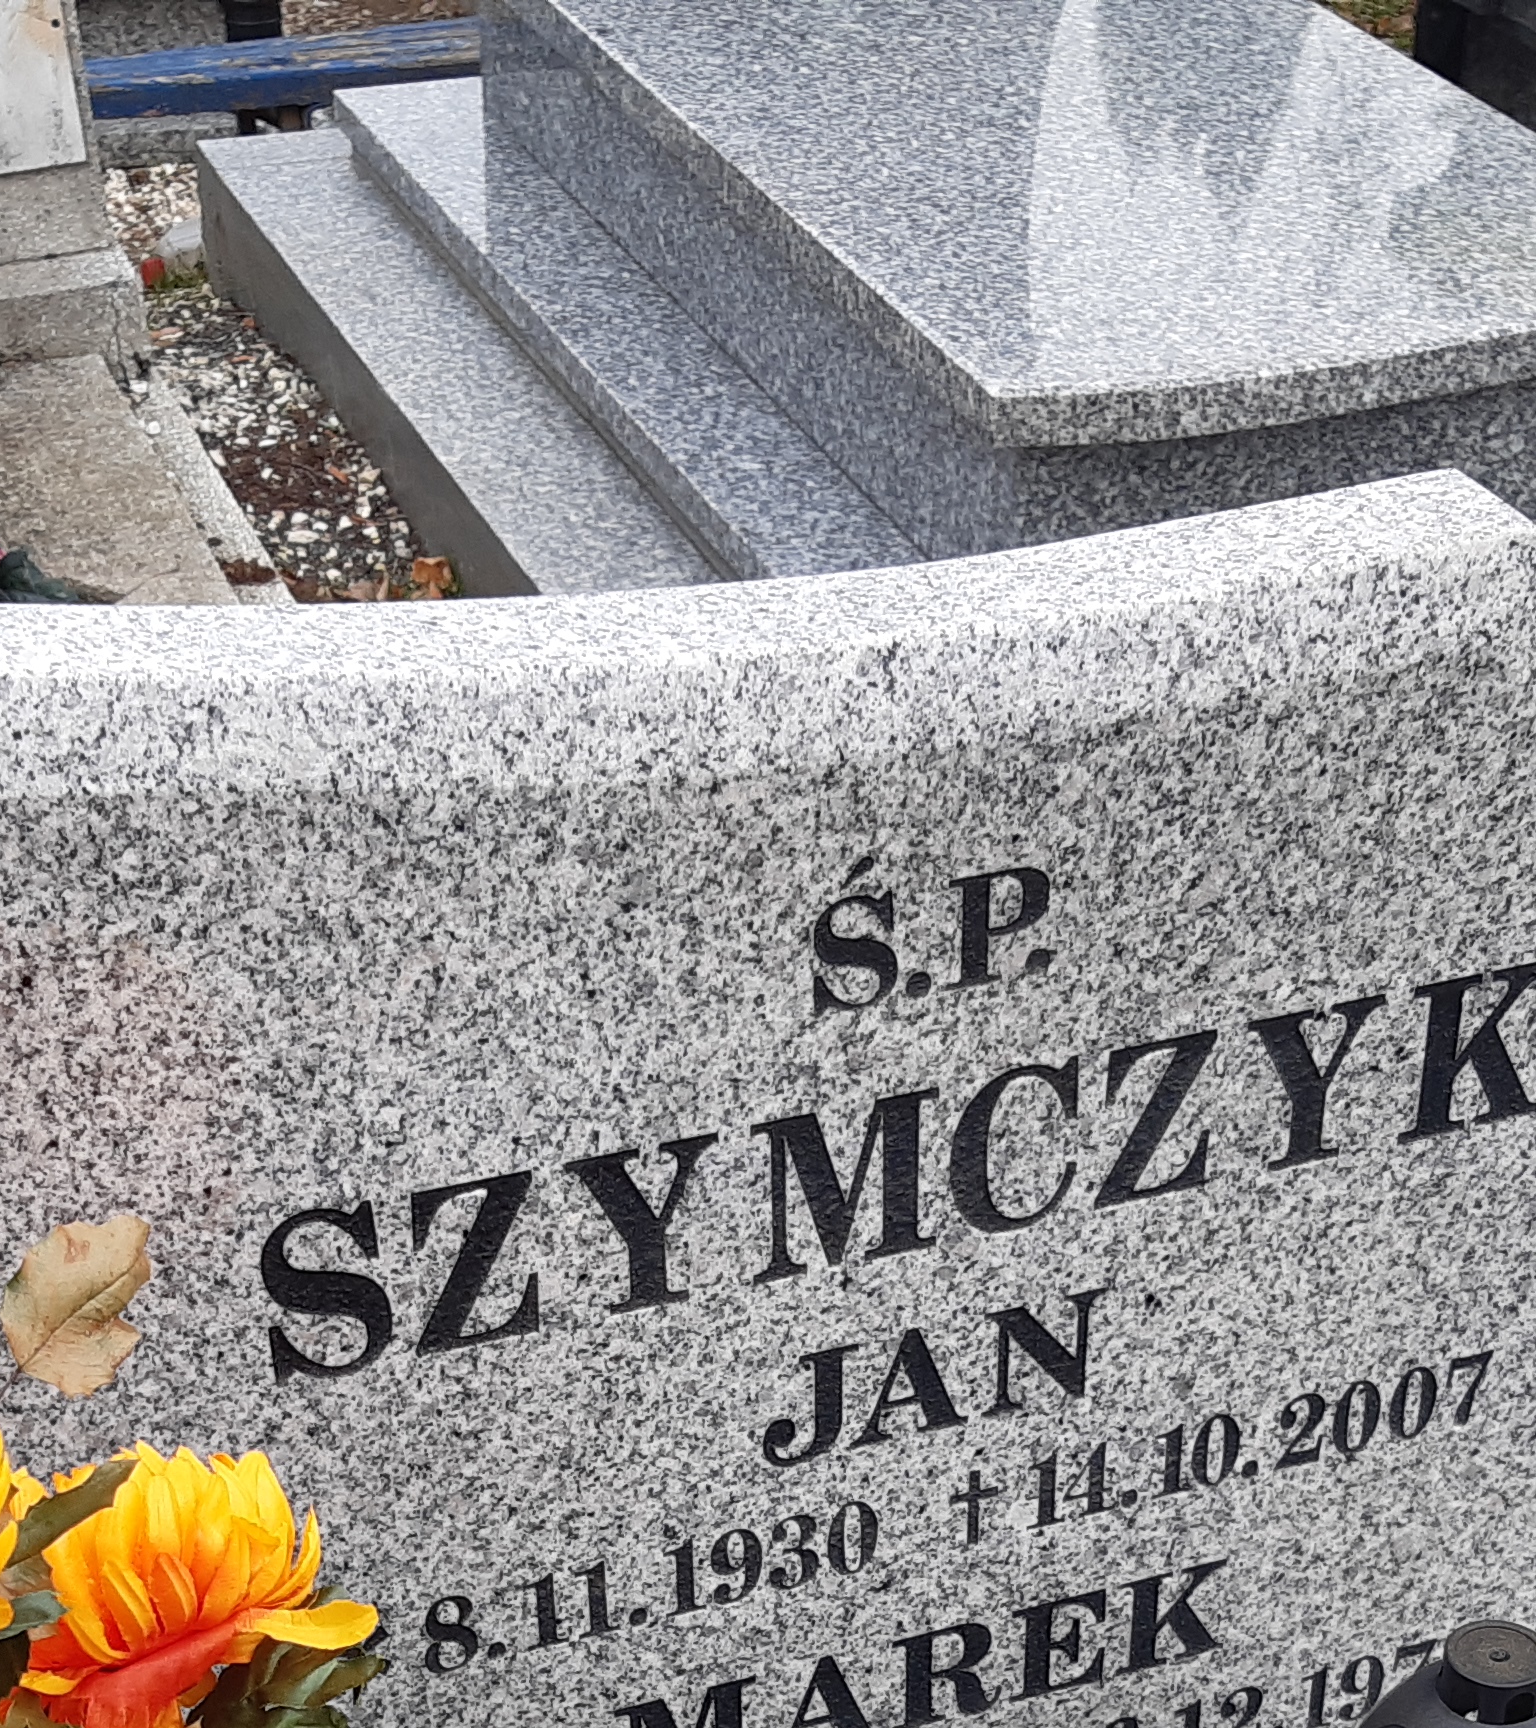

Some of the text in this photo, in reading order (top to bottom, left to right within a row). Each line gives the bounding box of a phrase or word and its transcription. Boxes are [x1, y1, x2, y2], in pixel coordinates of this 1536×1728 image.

[812, 857, 1054, 1012] Ś.P.
[763, 1288, 1109, 1468] JAN
[425, 1350, 1494, 1675] 8.11.1930 14.10.2007
